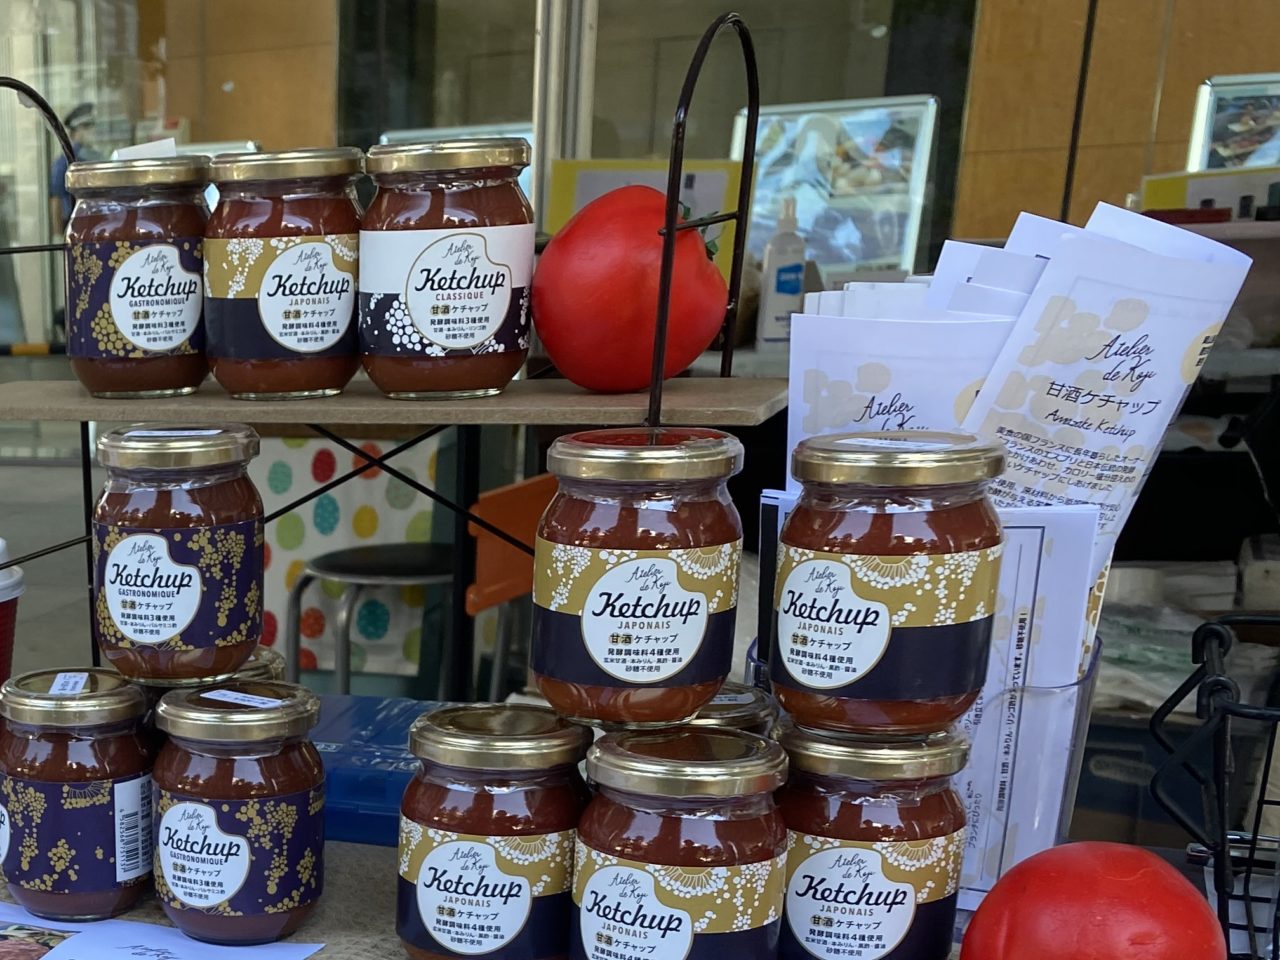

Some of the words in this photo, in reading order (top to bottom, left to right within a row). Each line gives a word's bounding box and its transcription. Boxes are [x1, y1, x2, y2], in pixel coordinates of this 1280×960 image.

[117, 275, 197, 301] Ketchup
[267, 273, 349, 300] Ketchup
[415, 267, 505, 295] Ketchup
[129, 297, 185, 307] GASTRONOMIQUE
[289, 297, 330, 305] JAPONAIS
[436, 292, 484, 300] CLASSIQUE
[1085, 334, 1155, 360] Atelier
[1103, 360, 1126, 381] de
[853, 392, 916, 422] Atelier
[1046, 381, 1162, 416] 甘酒ケチャップ
[110, 563, 192, 594] Ketchup
[118, 589, 175, 597] GASTRONOMIQUE
[592, 592, 700, 624] Ketchup
[783, 590, 879, 633] Ketchup
[618, 621, 671, 629] JAPONAIS
[798, 622, 844, 635] JAPONAIS
[610, 633, 679, 644] 甘酒ケチャップ
[163, 827, 240, 863] Ketchup
[170, 851, 224, 865] GASTRONOMIQUE
[424, 867, 522, 905] Ketchup
[795, 875, 907, 913] Ketchup
[444, 896, 491, 907] JAPONAIS
[820, 905, 874, 916] JAPONAIS
[586, 890, 682, 938] Ketchup
[812, 915, 882, 929] 甘酒ケチャップ
[602, 923, 648, 939] JAPONAIS
